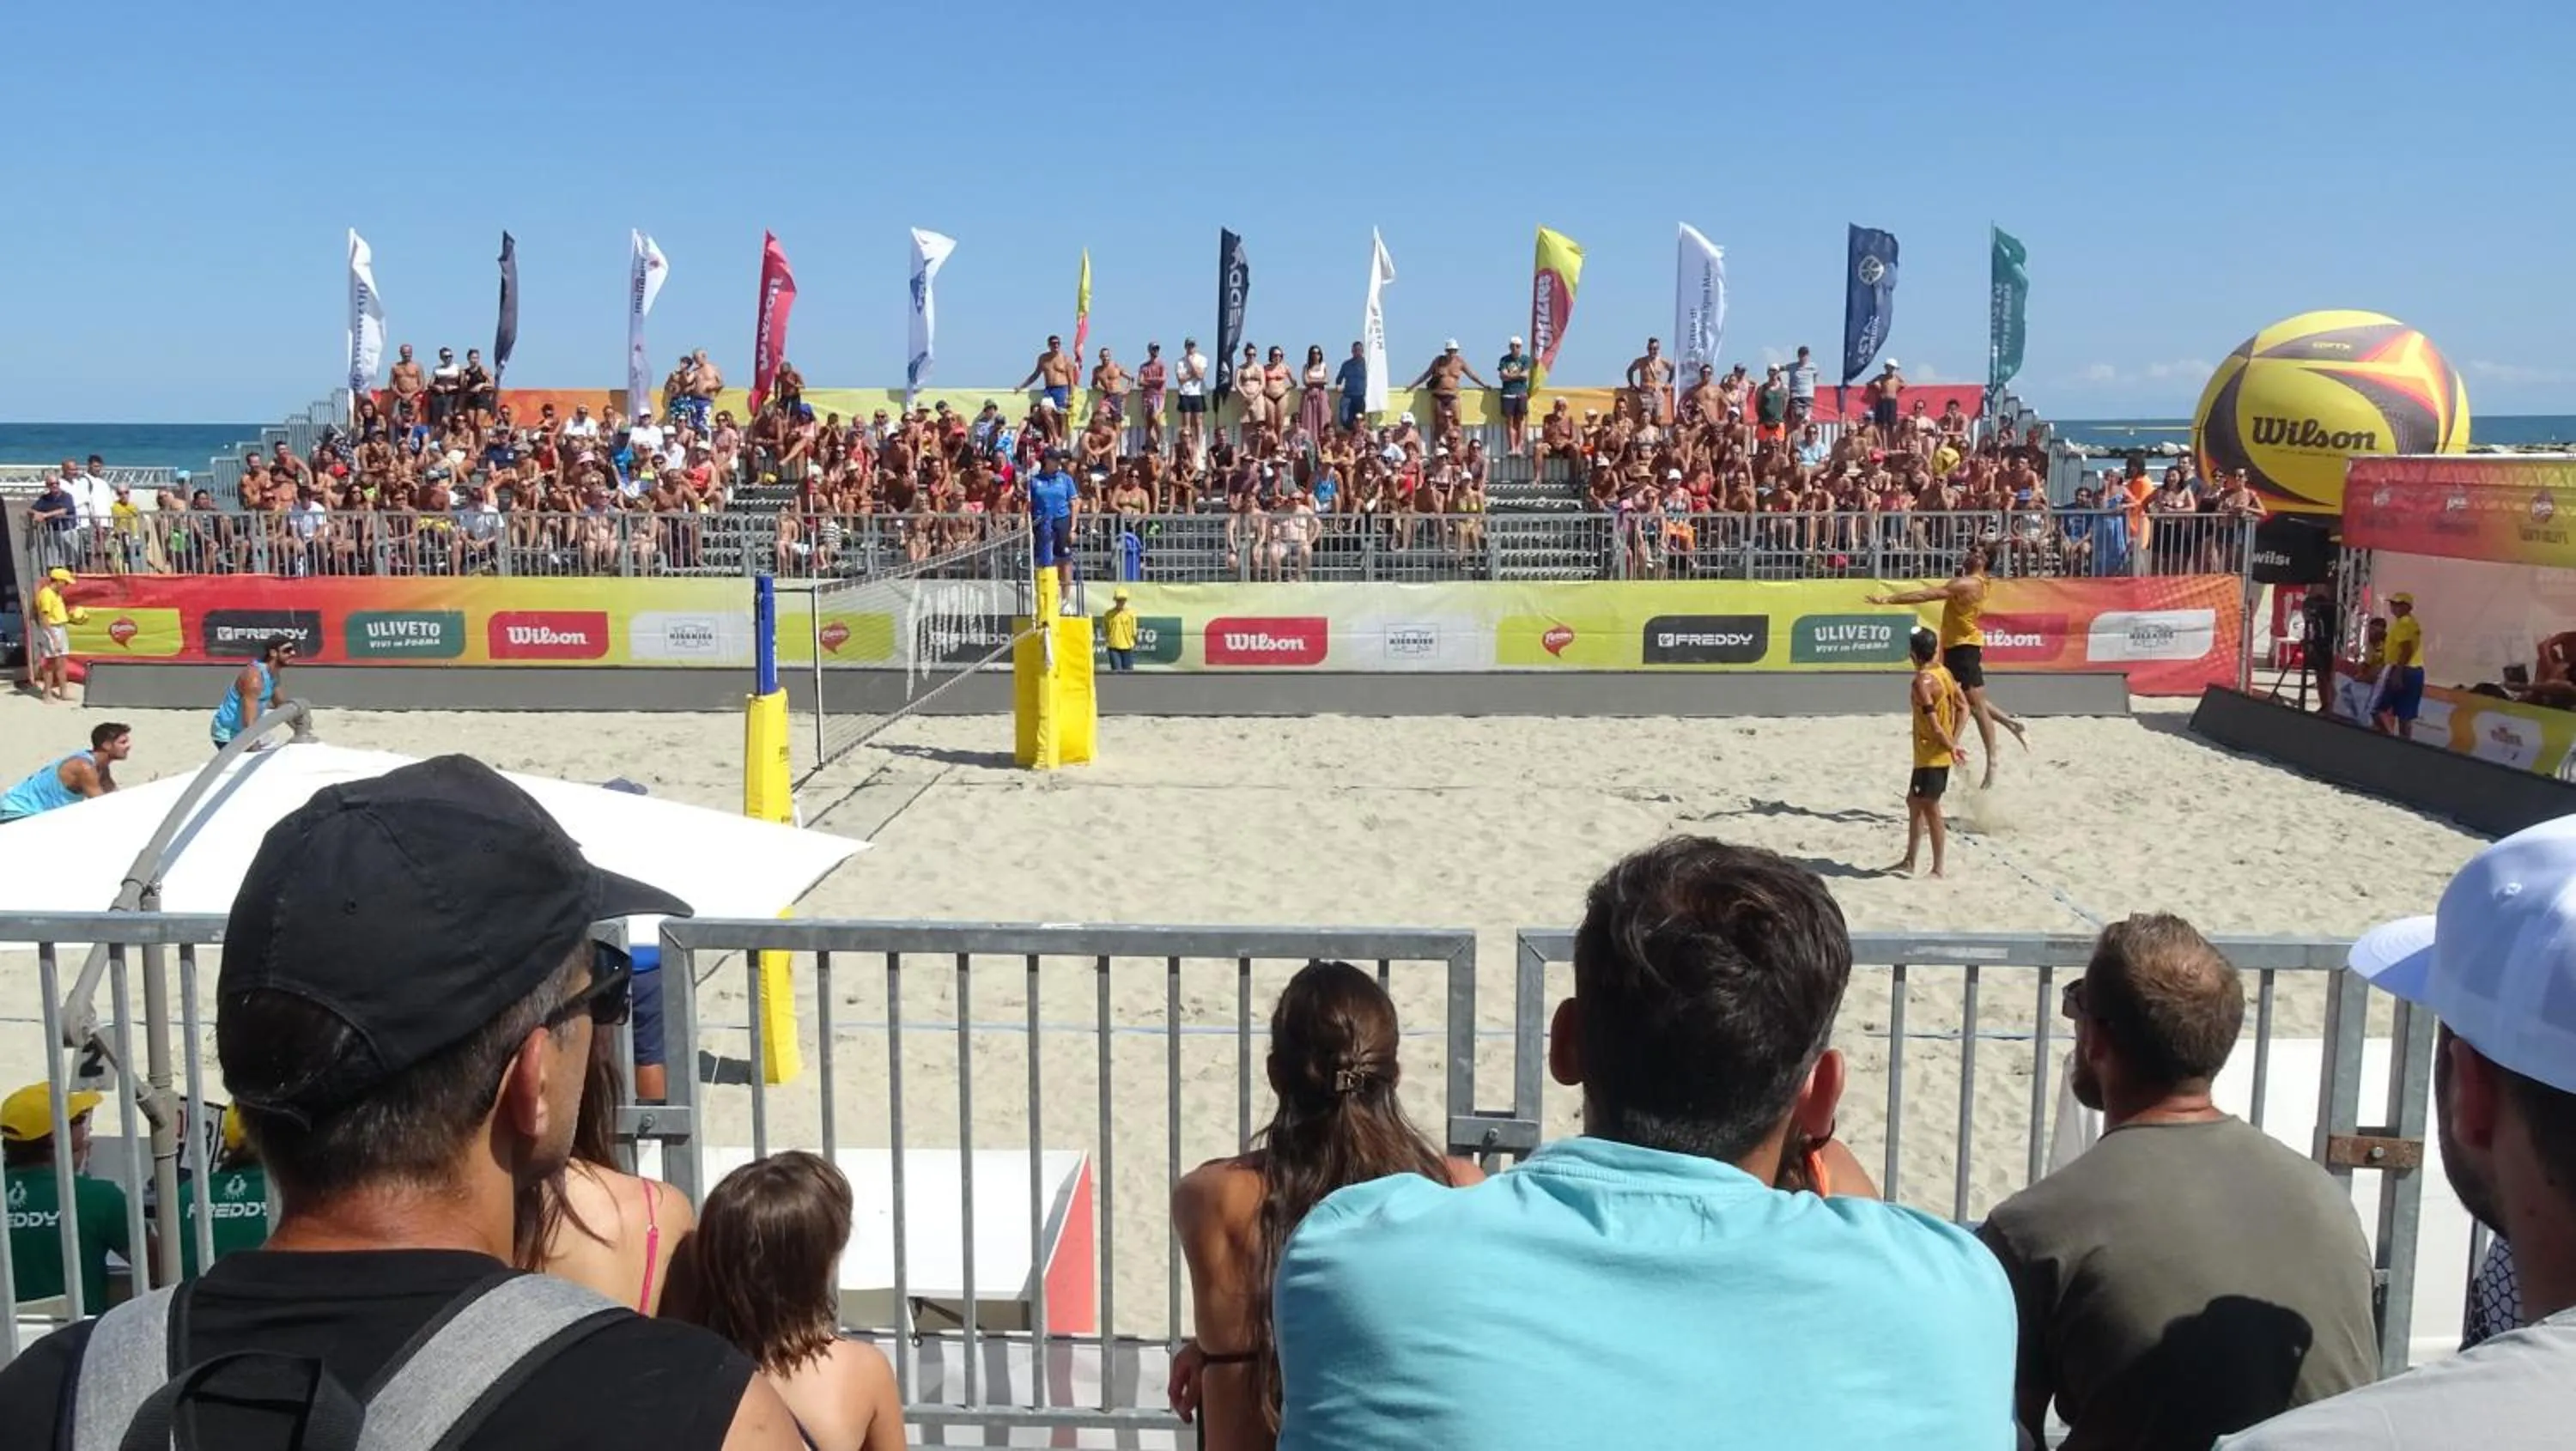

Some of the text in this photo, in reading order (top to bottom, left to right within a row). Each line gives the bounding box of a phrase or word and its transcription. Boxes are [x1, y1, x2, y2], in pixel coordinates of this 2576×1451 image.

[2252, 416, 2376, 450] Wilson
[367, 621, 440, 637] ULIVETO
[507, 627, 587, 645] Wilson
[1815, 625, 1891, 641] ULIVETO
[1980, 629, 2044, 647] ilson
[1224, 633, 1304, 651] Wilson
[1675, 634, 1753, 646] FREDDY
[186, 1201, 267, 1219] FEDD
[7, 1211, 61, 1228] EDDY
